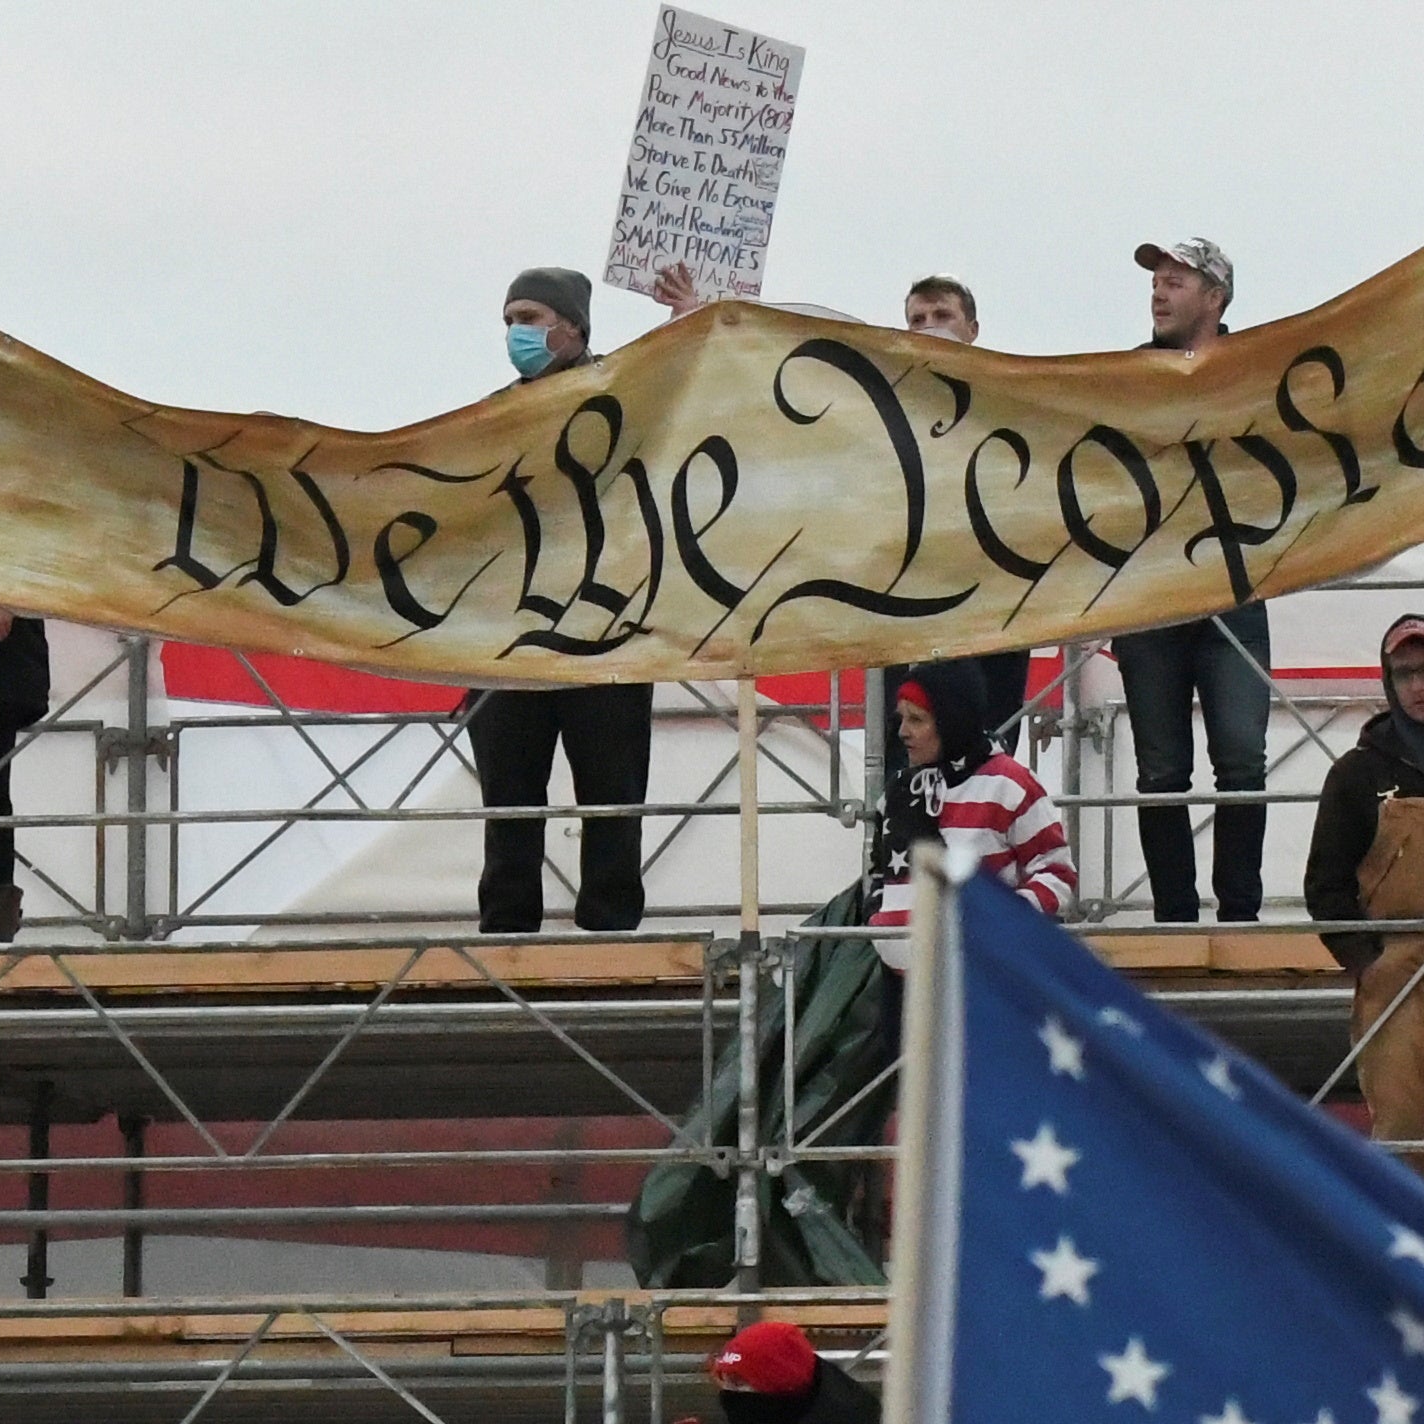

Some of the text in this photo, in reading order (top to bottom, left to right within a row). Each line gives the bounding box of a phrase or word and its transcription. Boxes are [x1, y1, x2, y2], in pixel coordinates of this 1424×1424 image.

[653, 9, 790, 80] Jesus Is King
[647, 73, 680, 109] Poor
[667, 53, 795, 104] Good News to the
[636, 107, 786, 159] More Than 55 Million
[631, 135, 690, 170] Starve
[694, 150, 707, 173] To
[711, 152, 753, 184] Death
[627, 164, 774, 214] We Give No Excuse
[614, 219, 759, 270] SMART PHONES
[621, 193, 639, 219] To
[643, 200, 686, 230] Mind
[689, 205, 744, 247] Reading
[609, 245, 649, 272] Mind
[150, 429, 503, 649] We
[490, 395, 803, 660] the
